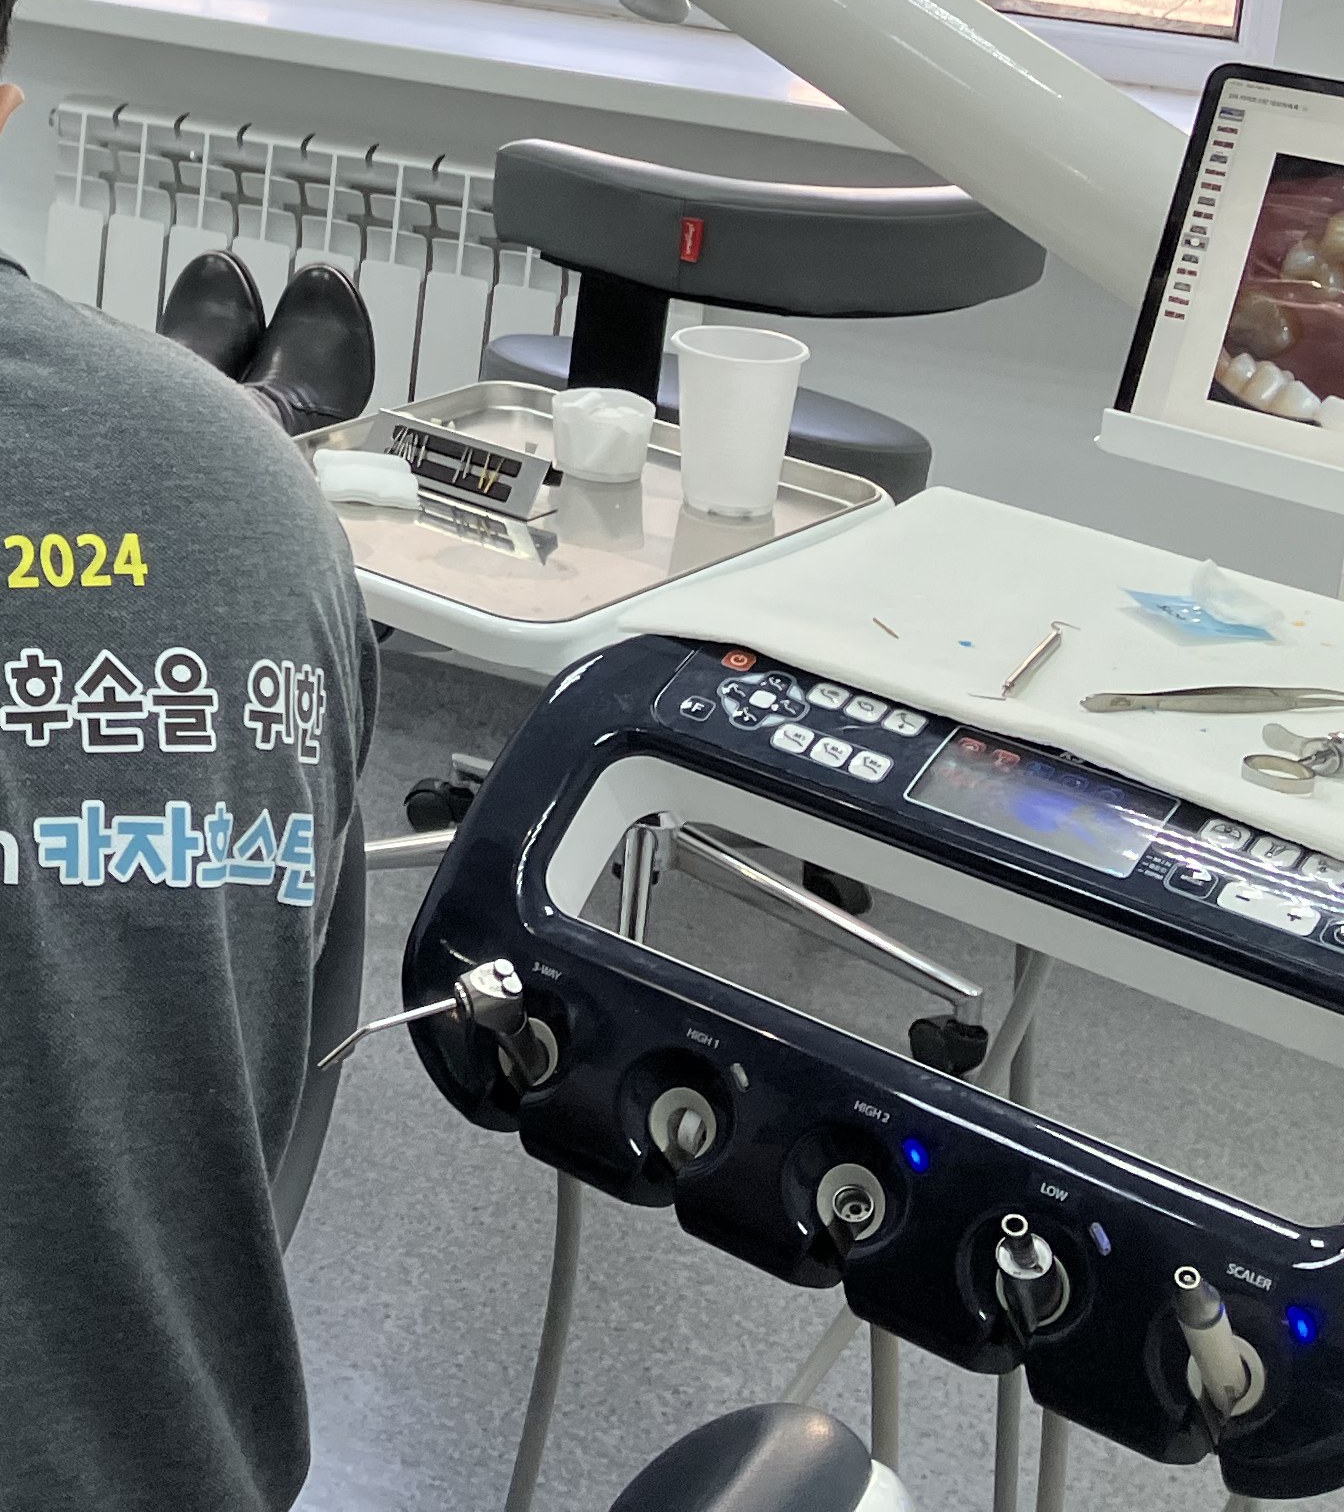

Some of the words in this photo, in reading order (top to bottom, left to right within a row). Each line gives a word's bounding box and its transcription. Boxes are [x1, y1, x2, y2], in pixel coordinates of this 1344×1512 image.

[0, 647, 218, 753] 후손을
[244, 658, 326, 763] 위한
[531, 961, 563, 981] 3-WAY
[686, 1027, 713, 1047] HIGH
[713, 1039, 720, 1050] 1
[853, 1100, 881, 1120] HIGH
[881, 1112, 891, 1124] 2
[1040, 1182, 1069, 1202] LOW
[1226, 1262, 1273, 1292] SCALER
